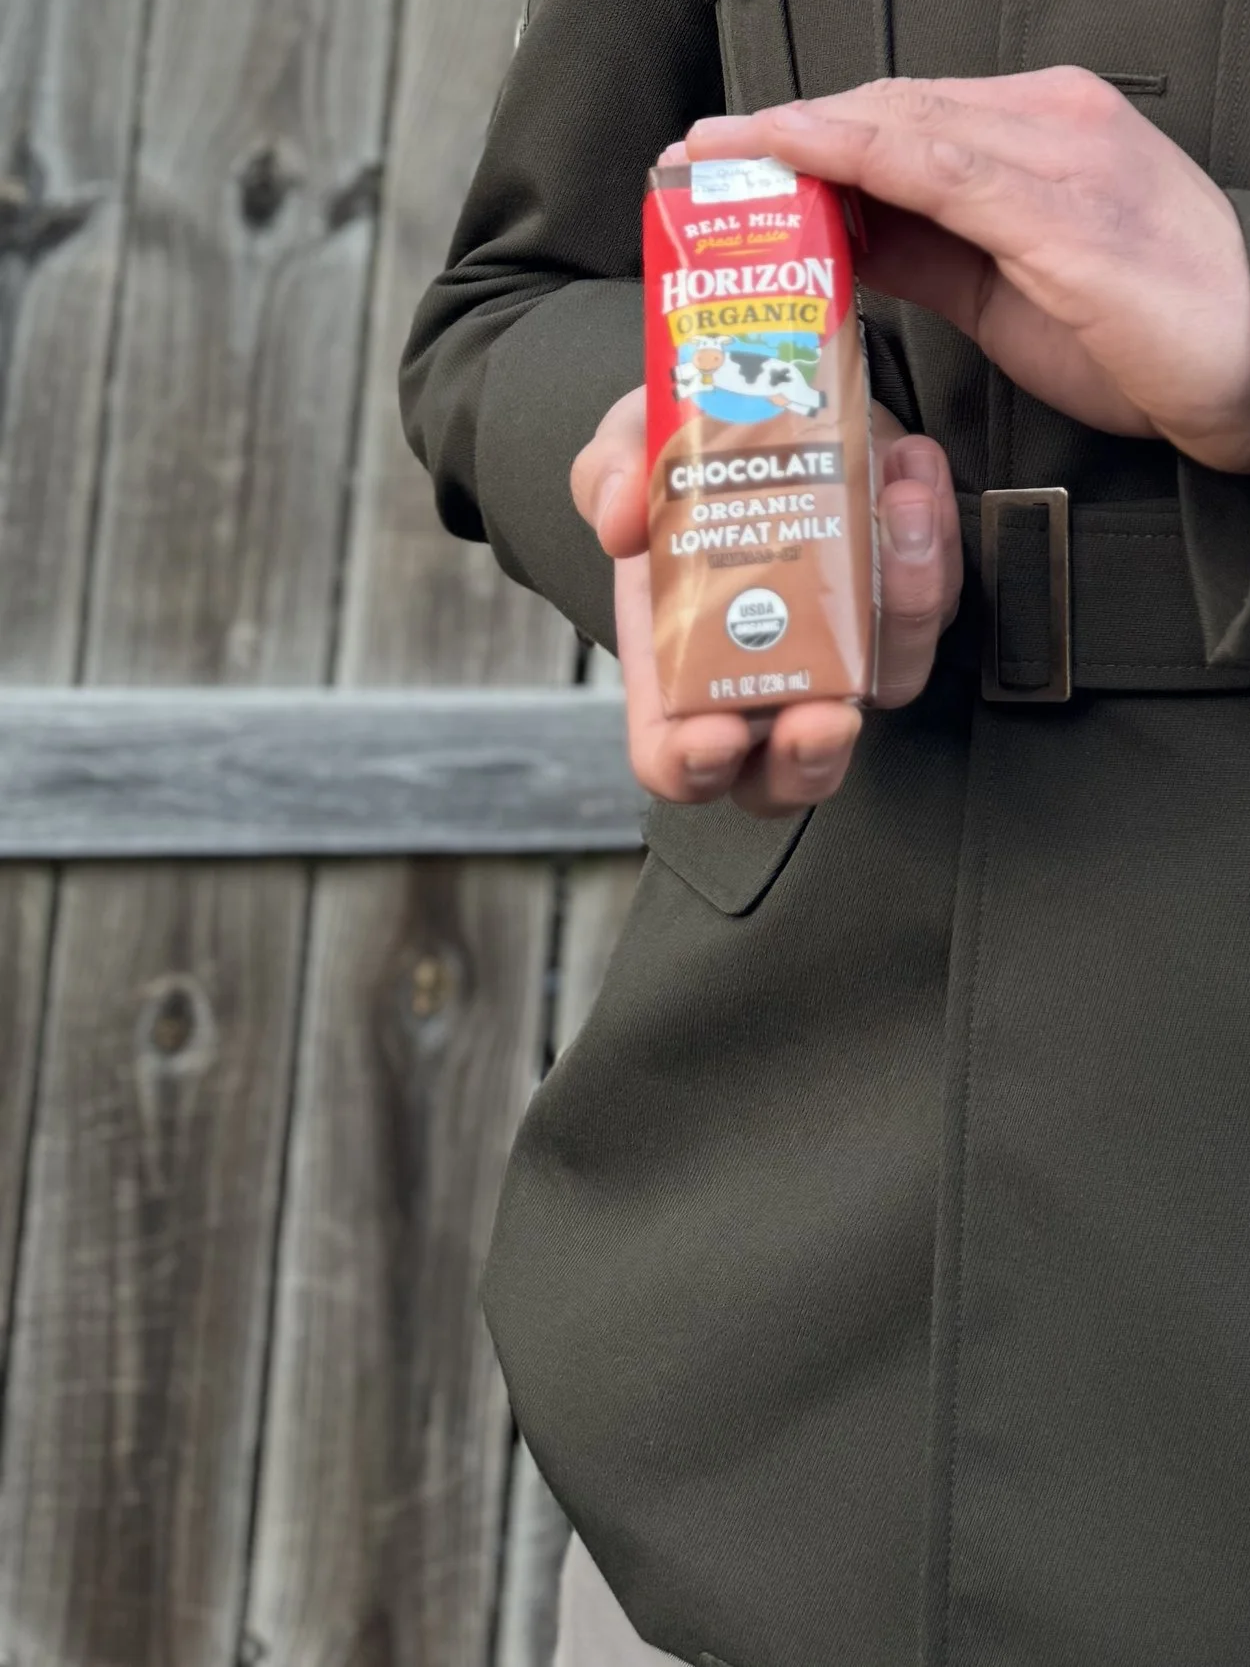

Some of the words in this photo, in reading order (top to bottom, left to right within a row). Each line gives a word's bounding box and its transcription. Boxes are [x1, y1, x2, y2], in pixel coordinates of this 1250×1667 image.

[684, 215, 741, 238] REAL
[748, 212, 802, 229] MILK
[695, 233, 743, 254] great
[661, 257, 835, 315] HORIZON
[676, 302, 819, 335] ORGANIC
[670, 452, 835, 490] CHOCOLATE
[692, 493, 816, 522] ORGANIC
[671, 521, 773, 555] LOWFAT
[778, 516, 842, 541] MILK
[740, 602, 774, 618] USDA
